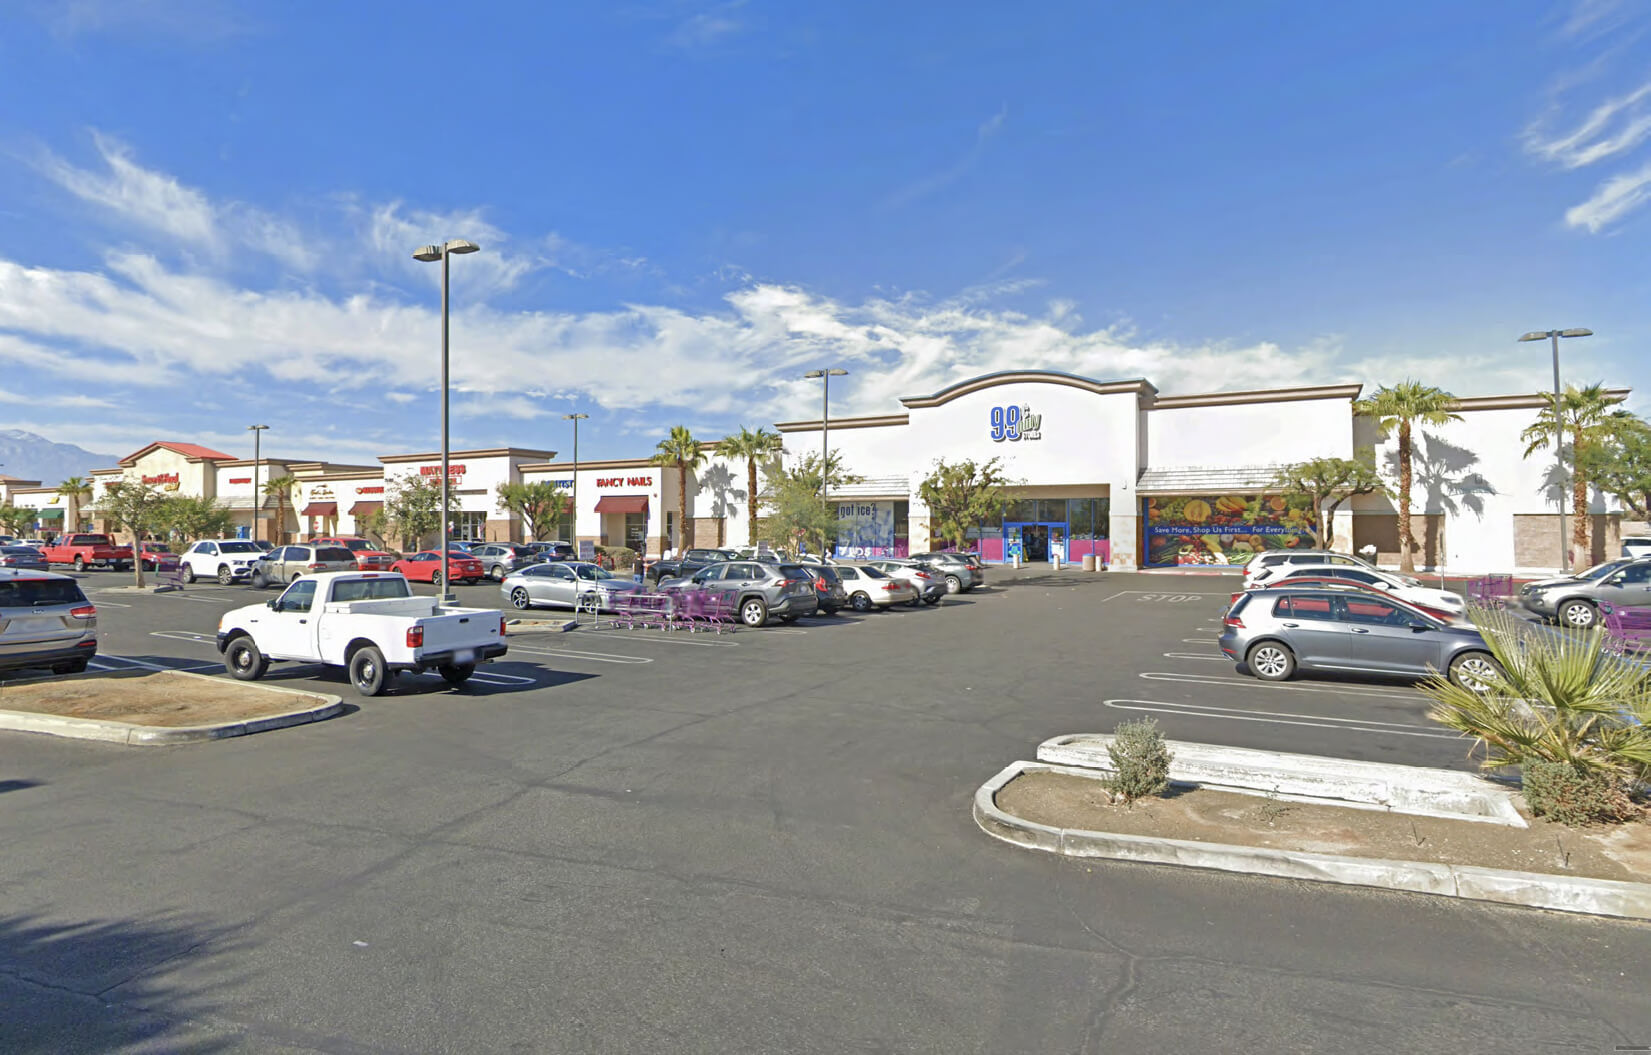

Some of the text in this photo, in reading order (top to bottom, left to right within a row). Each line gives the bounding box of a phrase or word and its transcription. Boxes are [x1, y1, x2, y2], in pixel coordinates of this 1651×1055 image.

[991, 405, 1022, 441] 99
[420, 464, 466, 475] MATTESS
[596, 476, 652, 487] FANCY NAILS
[840, 503, 876, 518] got ice?
[1193, 526, 1210, 535] Shop
[1136, 594, 1203, 603] STOP
